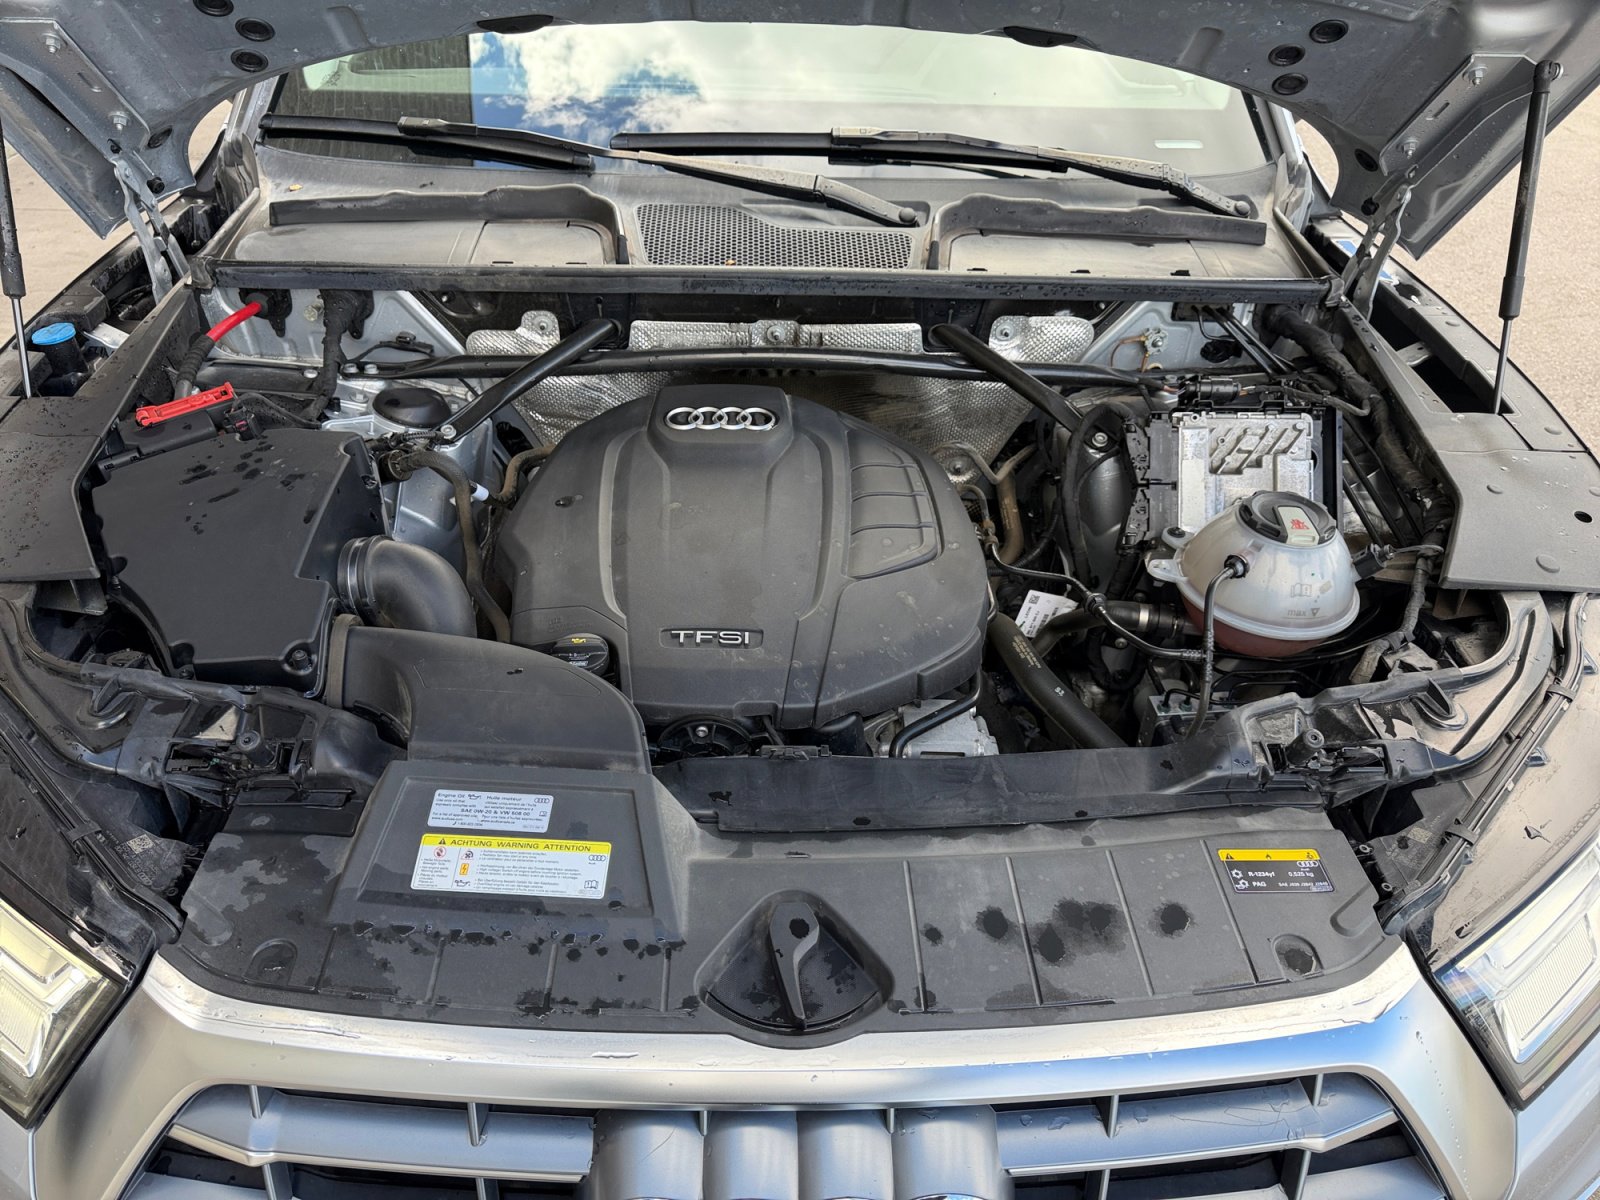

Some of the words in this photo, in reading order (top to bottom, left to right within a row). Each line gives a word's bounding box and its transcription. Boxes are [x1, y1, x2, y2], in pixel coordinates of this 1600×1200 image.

[1287, 609, 1307, 617] max
[671, 630, 750, 645] TFSI
[450, 839, 492, 848] ACHTUNG
[496, 841, 539, 850] WARNING
[544, 843, 592, 852] ATTENTION
